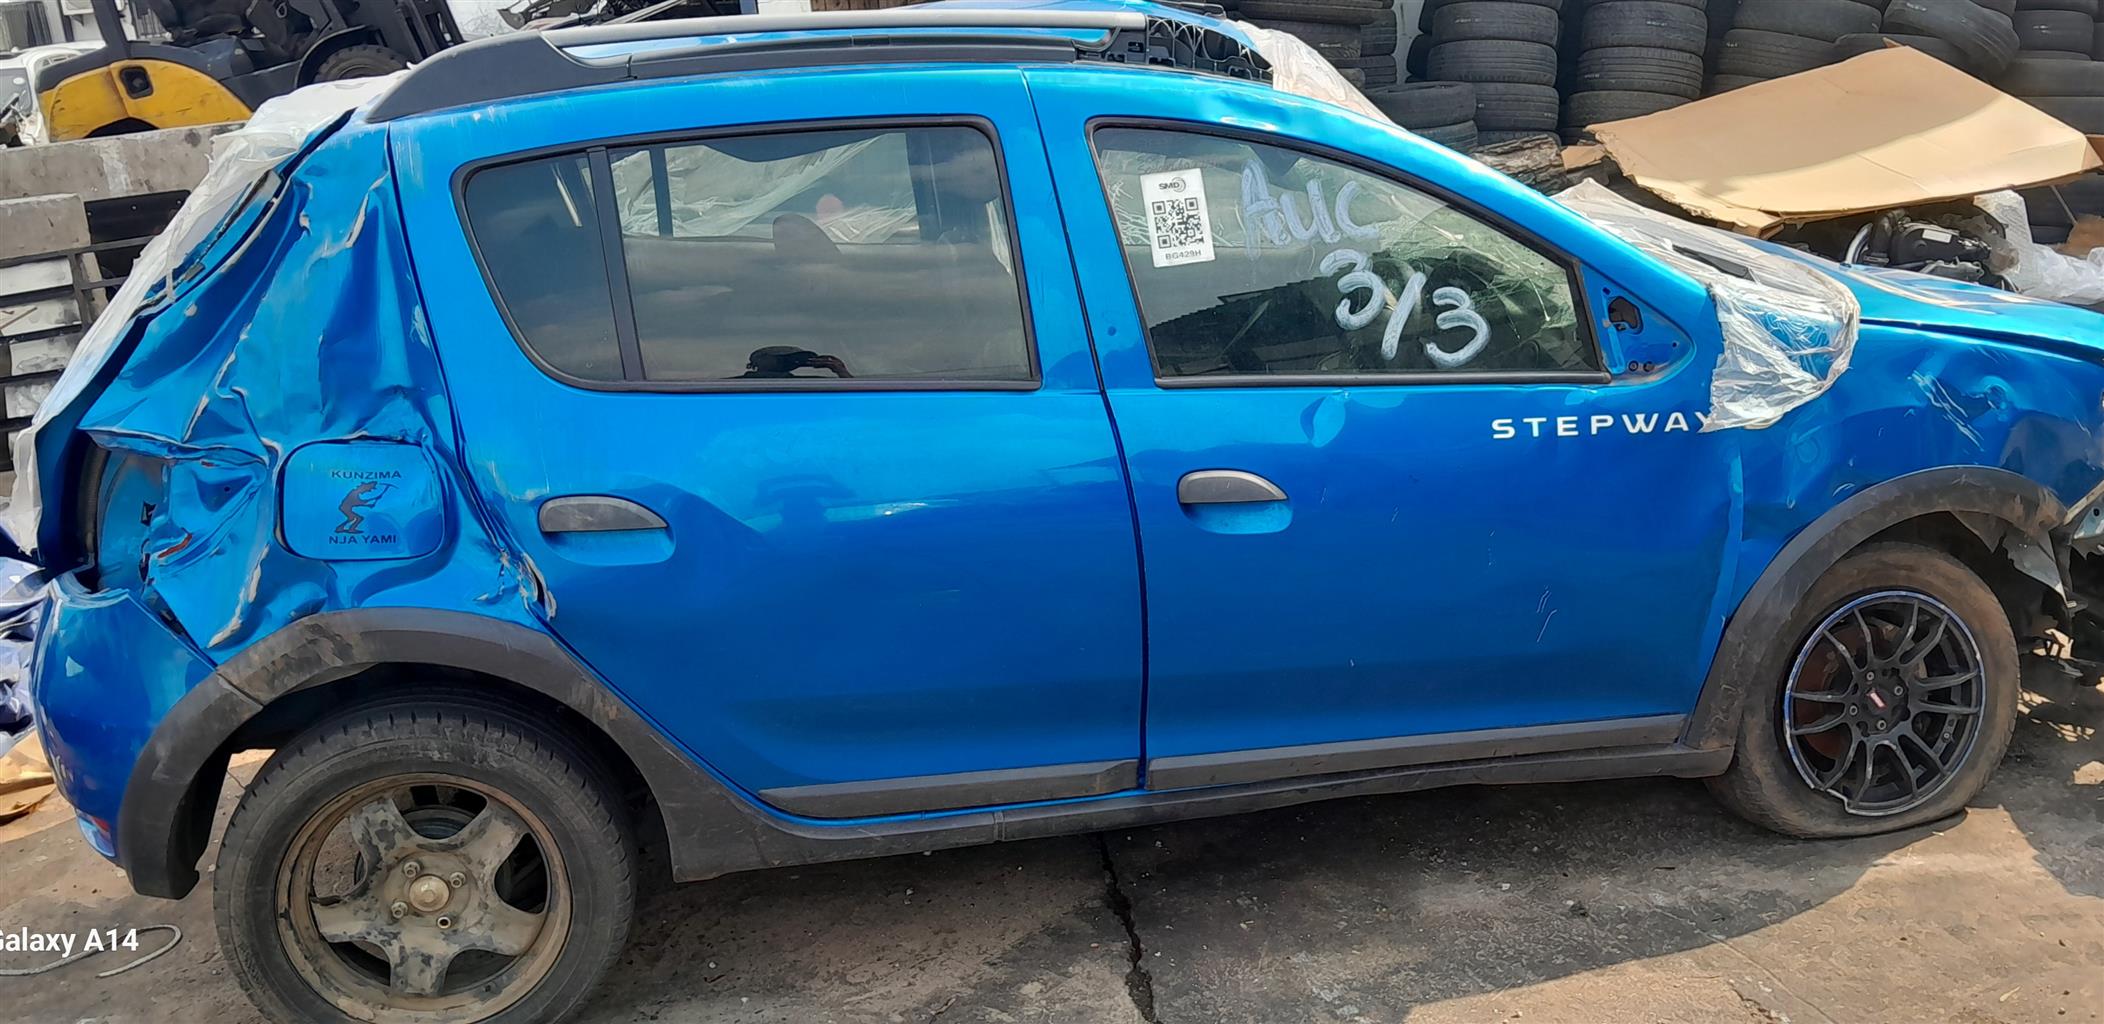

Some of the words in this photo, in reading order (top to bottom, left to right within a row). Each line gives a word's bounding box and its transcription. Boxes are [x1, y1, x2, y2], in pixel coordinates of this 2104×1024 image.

[1158, 181, 1181, 190] SMD
[1165, 249, 1201, 260] BG429H
[1319, 249, 1491, 367] 3/3
[331, 470, 402, 480] KUNZIMA
[328, 535, 358, 545] NJA
[362, 534, 397, 544] YAMI
